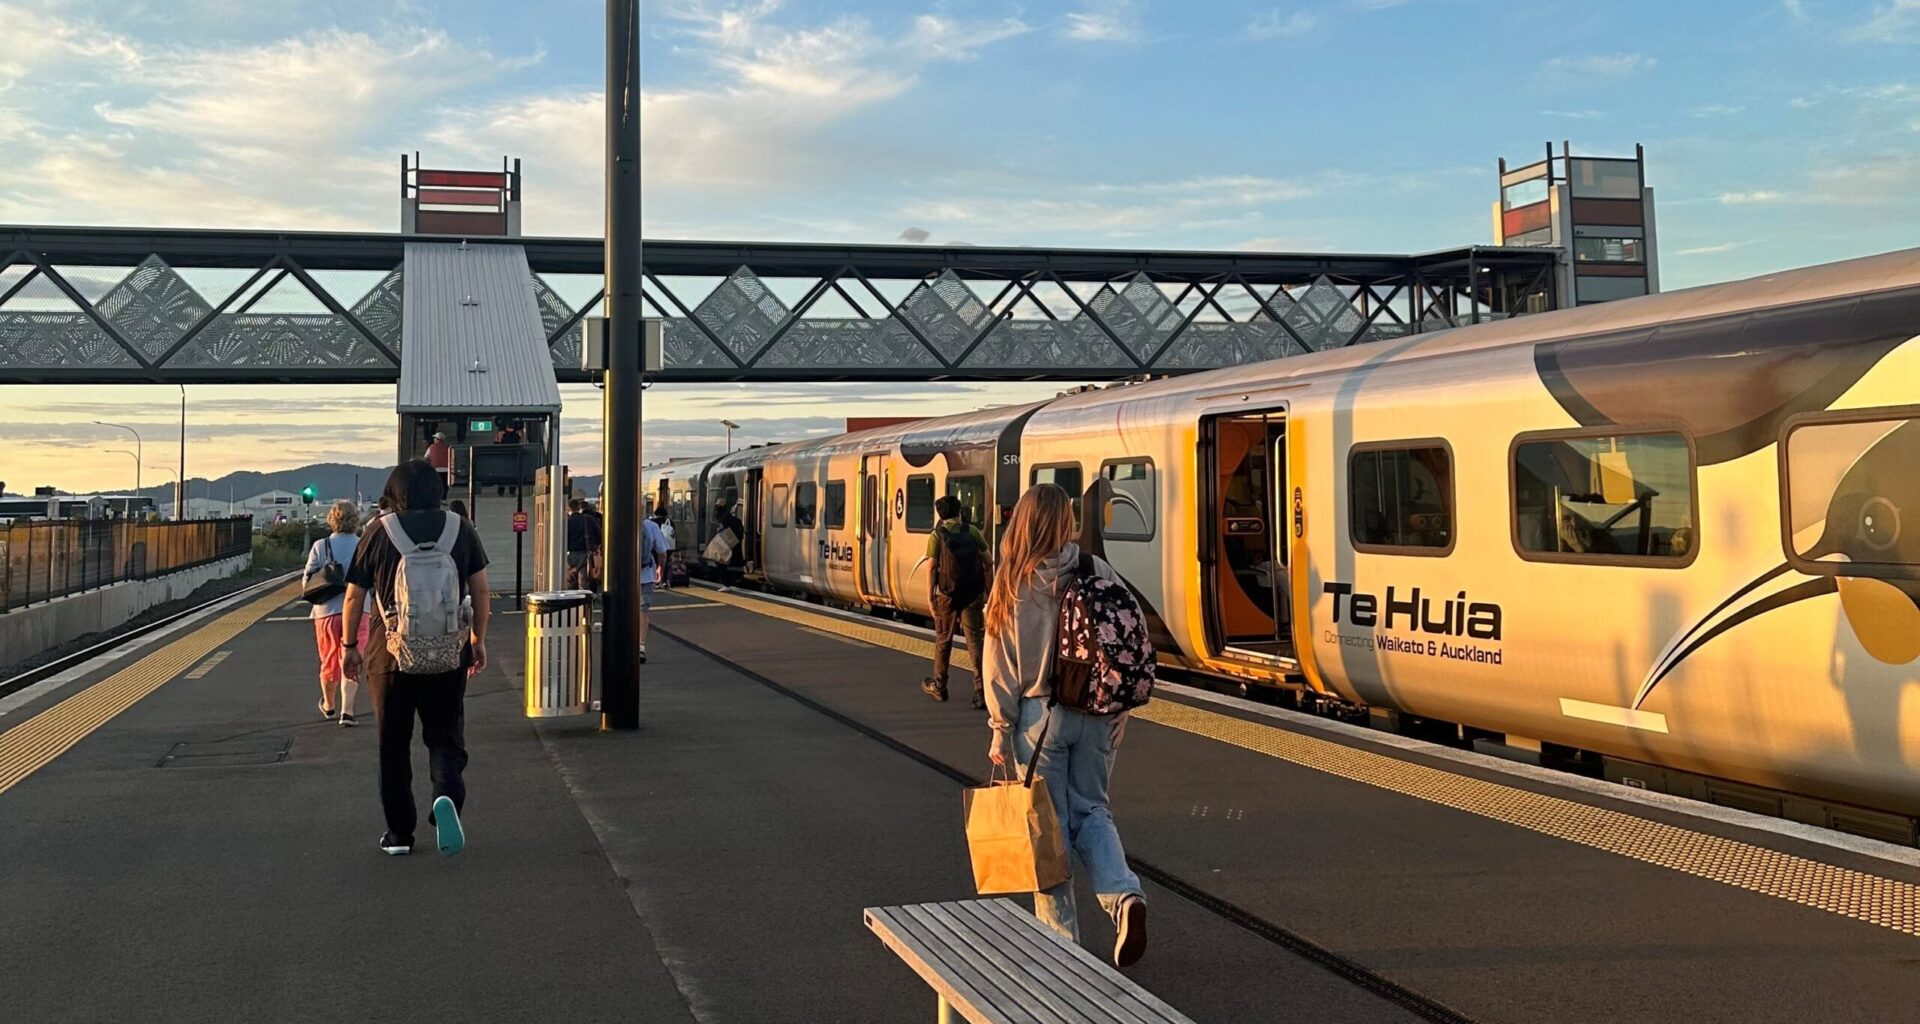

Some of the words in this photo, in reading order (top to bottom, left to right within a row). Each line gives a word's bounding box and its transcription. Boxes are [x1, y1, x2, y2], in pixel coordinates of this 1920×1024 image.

[819, 540, 830, 559] Te
[831, 541, 853, 562] Huia
[1324, 582, 1377, 627] Te
[1385, 586, 1502, 641] Huia
[1325, 630, 1375, 651] Connecting
[1376, 634, 1424, 655] Waikato
[1427, 640, 1438, 656] &
[1440, 642, 1502, 665] Auckland
